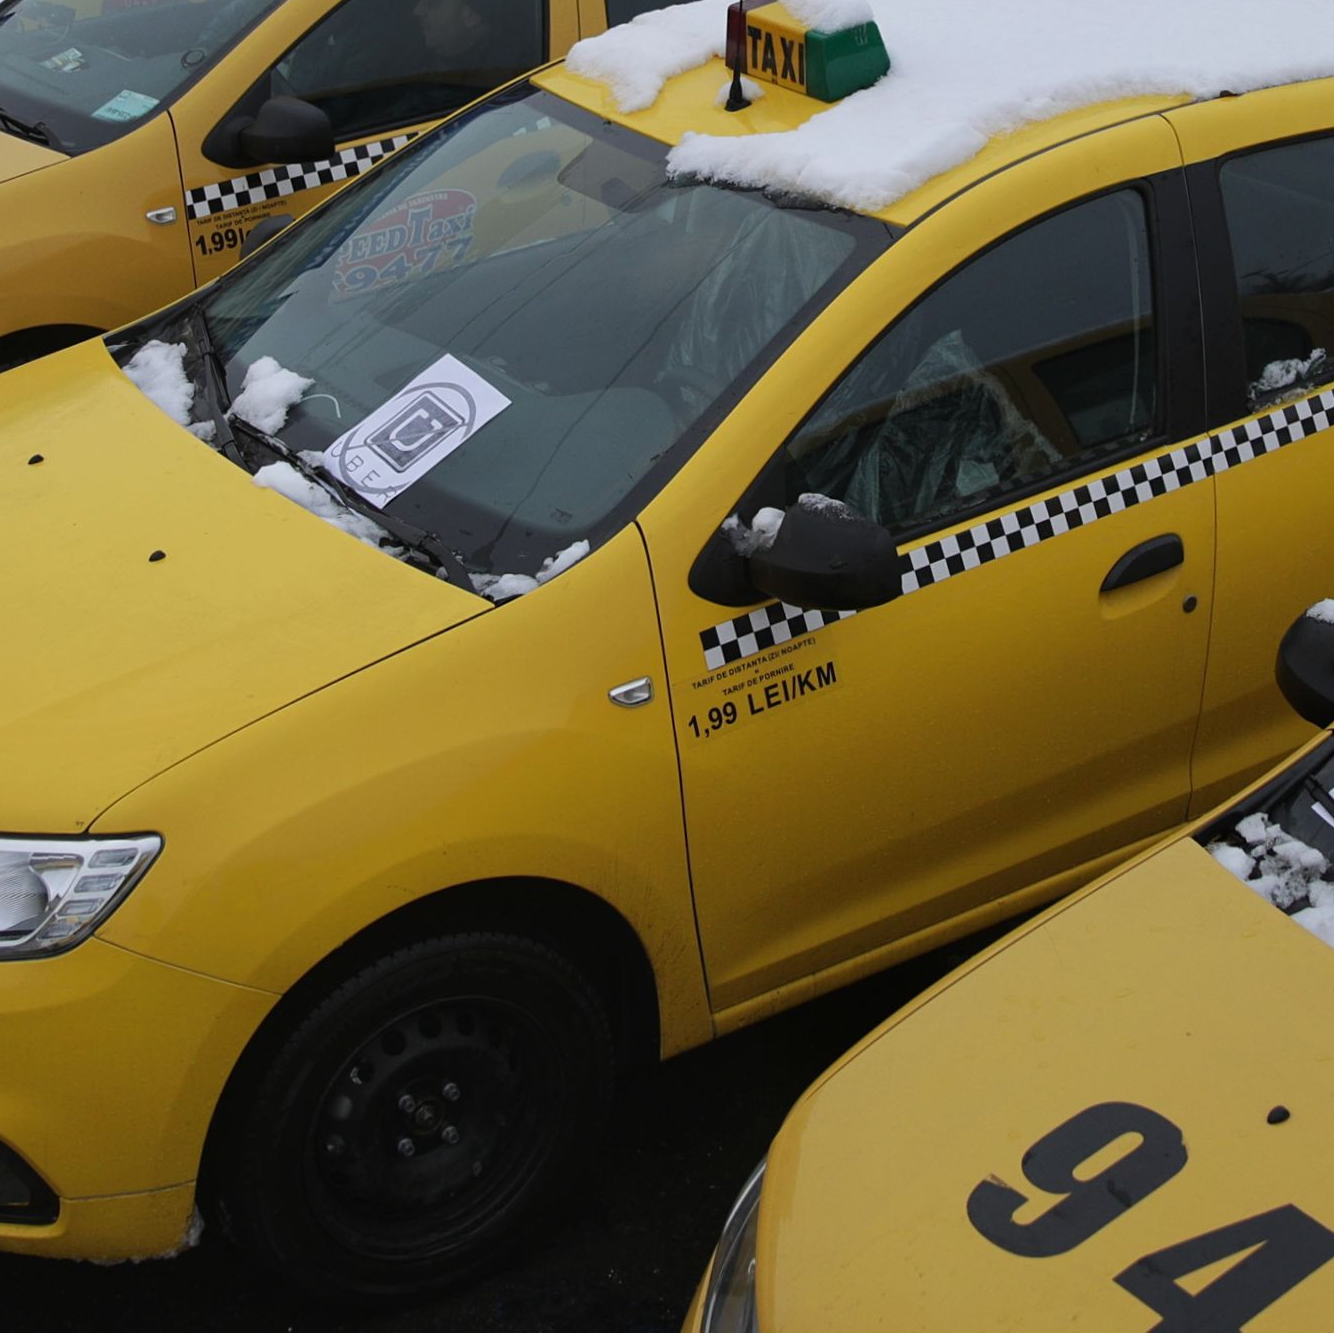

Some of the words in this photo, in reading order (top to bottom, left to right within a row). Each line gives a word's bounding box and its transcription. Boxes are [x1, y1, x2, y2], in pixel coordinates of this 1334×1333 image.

[747, 25, 805, 86] TAXI
[330, 440, 398, 505] UBER
[688, 701, 738, 739] 1,99
[748, 661, 837, 716] LEI/KM
[692, 676, 716, 690] TARIF
[716, 671, 728, 681] DE
[729, 658, 768, 677] DISTANTA
[722, 682, 745, 696] TARIF
[747, 678, 757, 687] DE
[759, 663, 795, 681] PORNIRE
